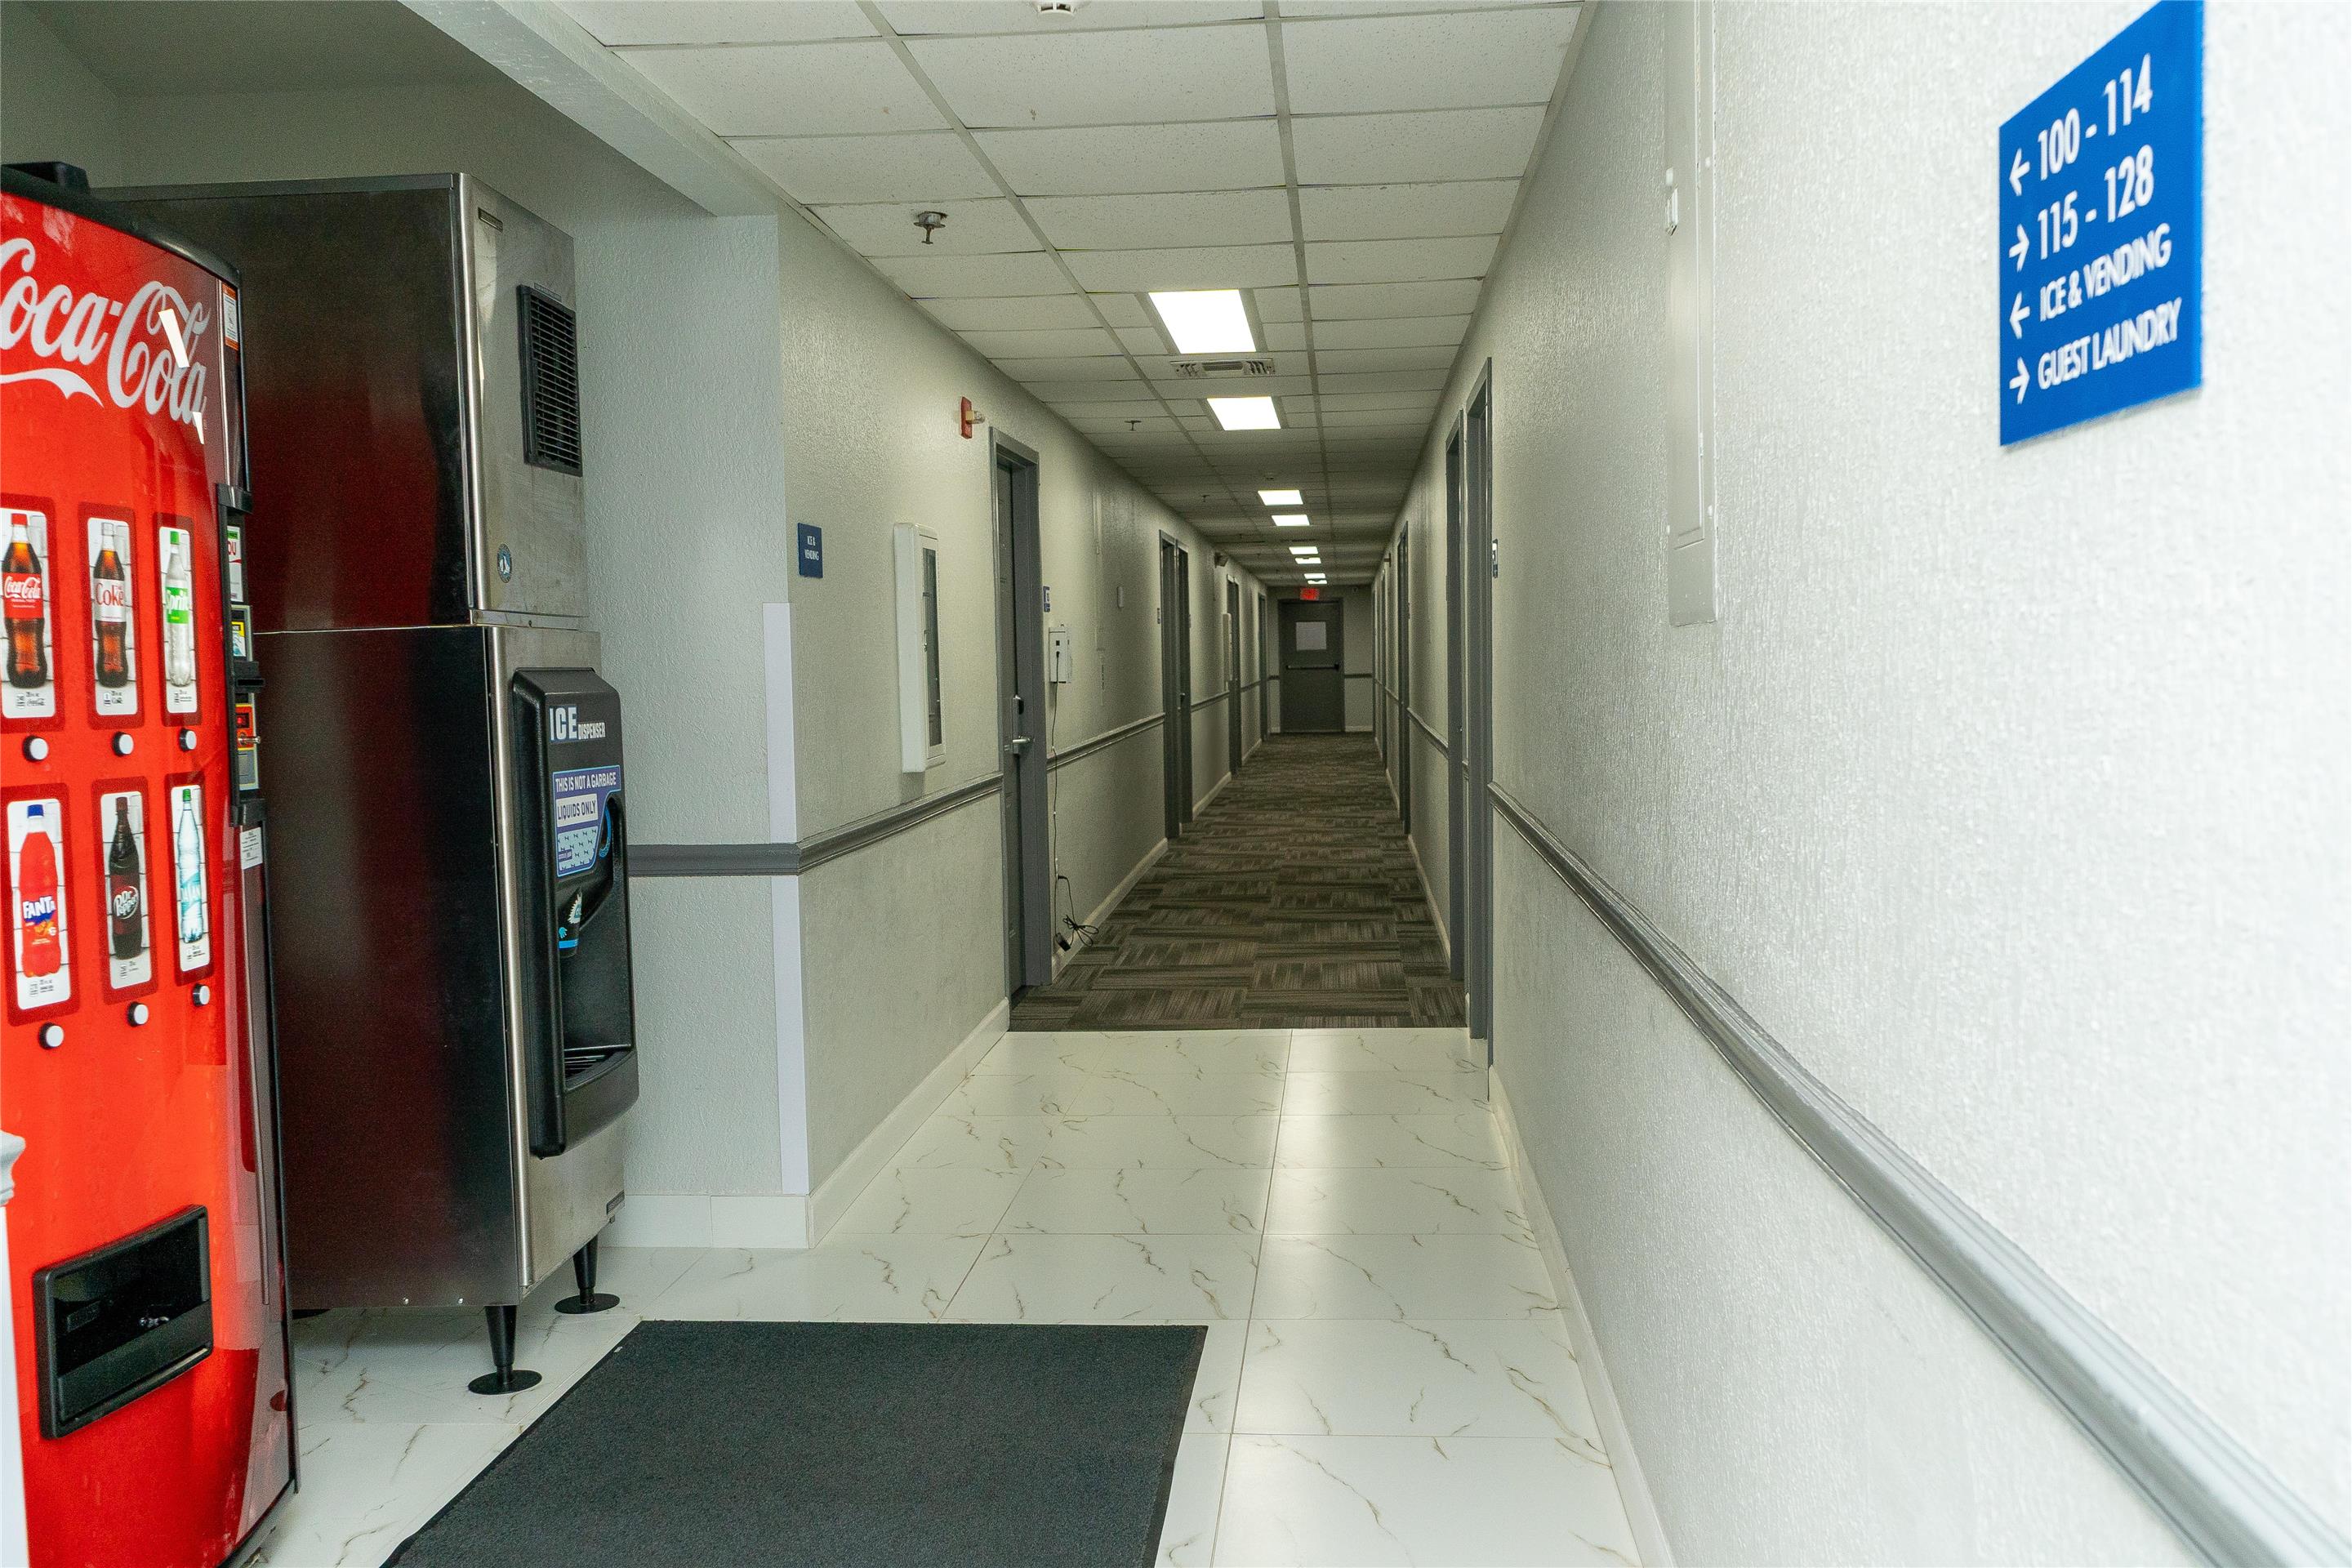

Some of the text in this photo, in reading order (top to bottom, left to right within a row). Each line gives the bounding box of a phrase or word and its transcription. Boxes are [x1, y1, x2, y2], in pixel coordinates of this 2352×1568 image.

[2038, 52, 2154, 181] 100 - 114
[2038, 144, 2154, 261] 115 - 128
[2040, 222, 2172, 322] ICE & VENDING
[2038, 296, 2182, 390] GUEST LAUNDRY
[96, 582, 124, 606] Coke
[549, 706, 606, 741] ICE DISPENSER
[555, 772, 617, 792] THIS IS NOT A GARBAGE
[557, 800, 597, 821] LIQUIDS ONLY
